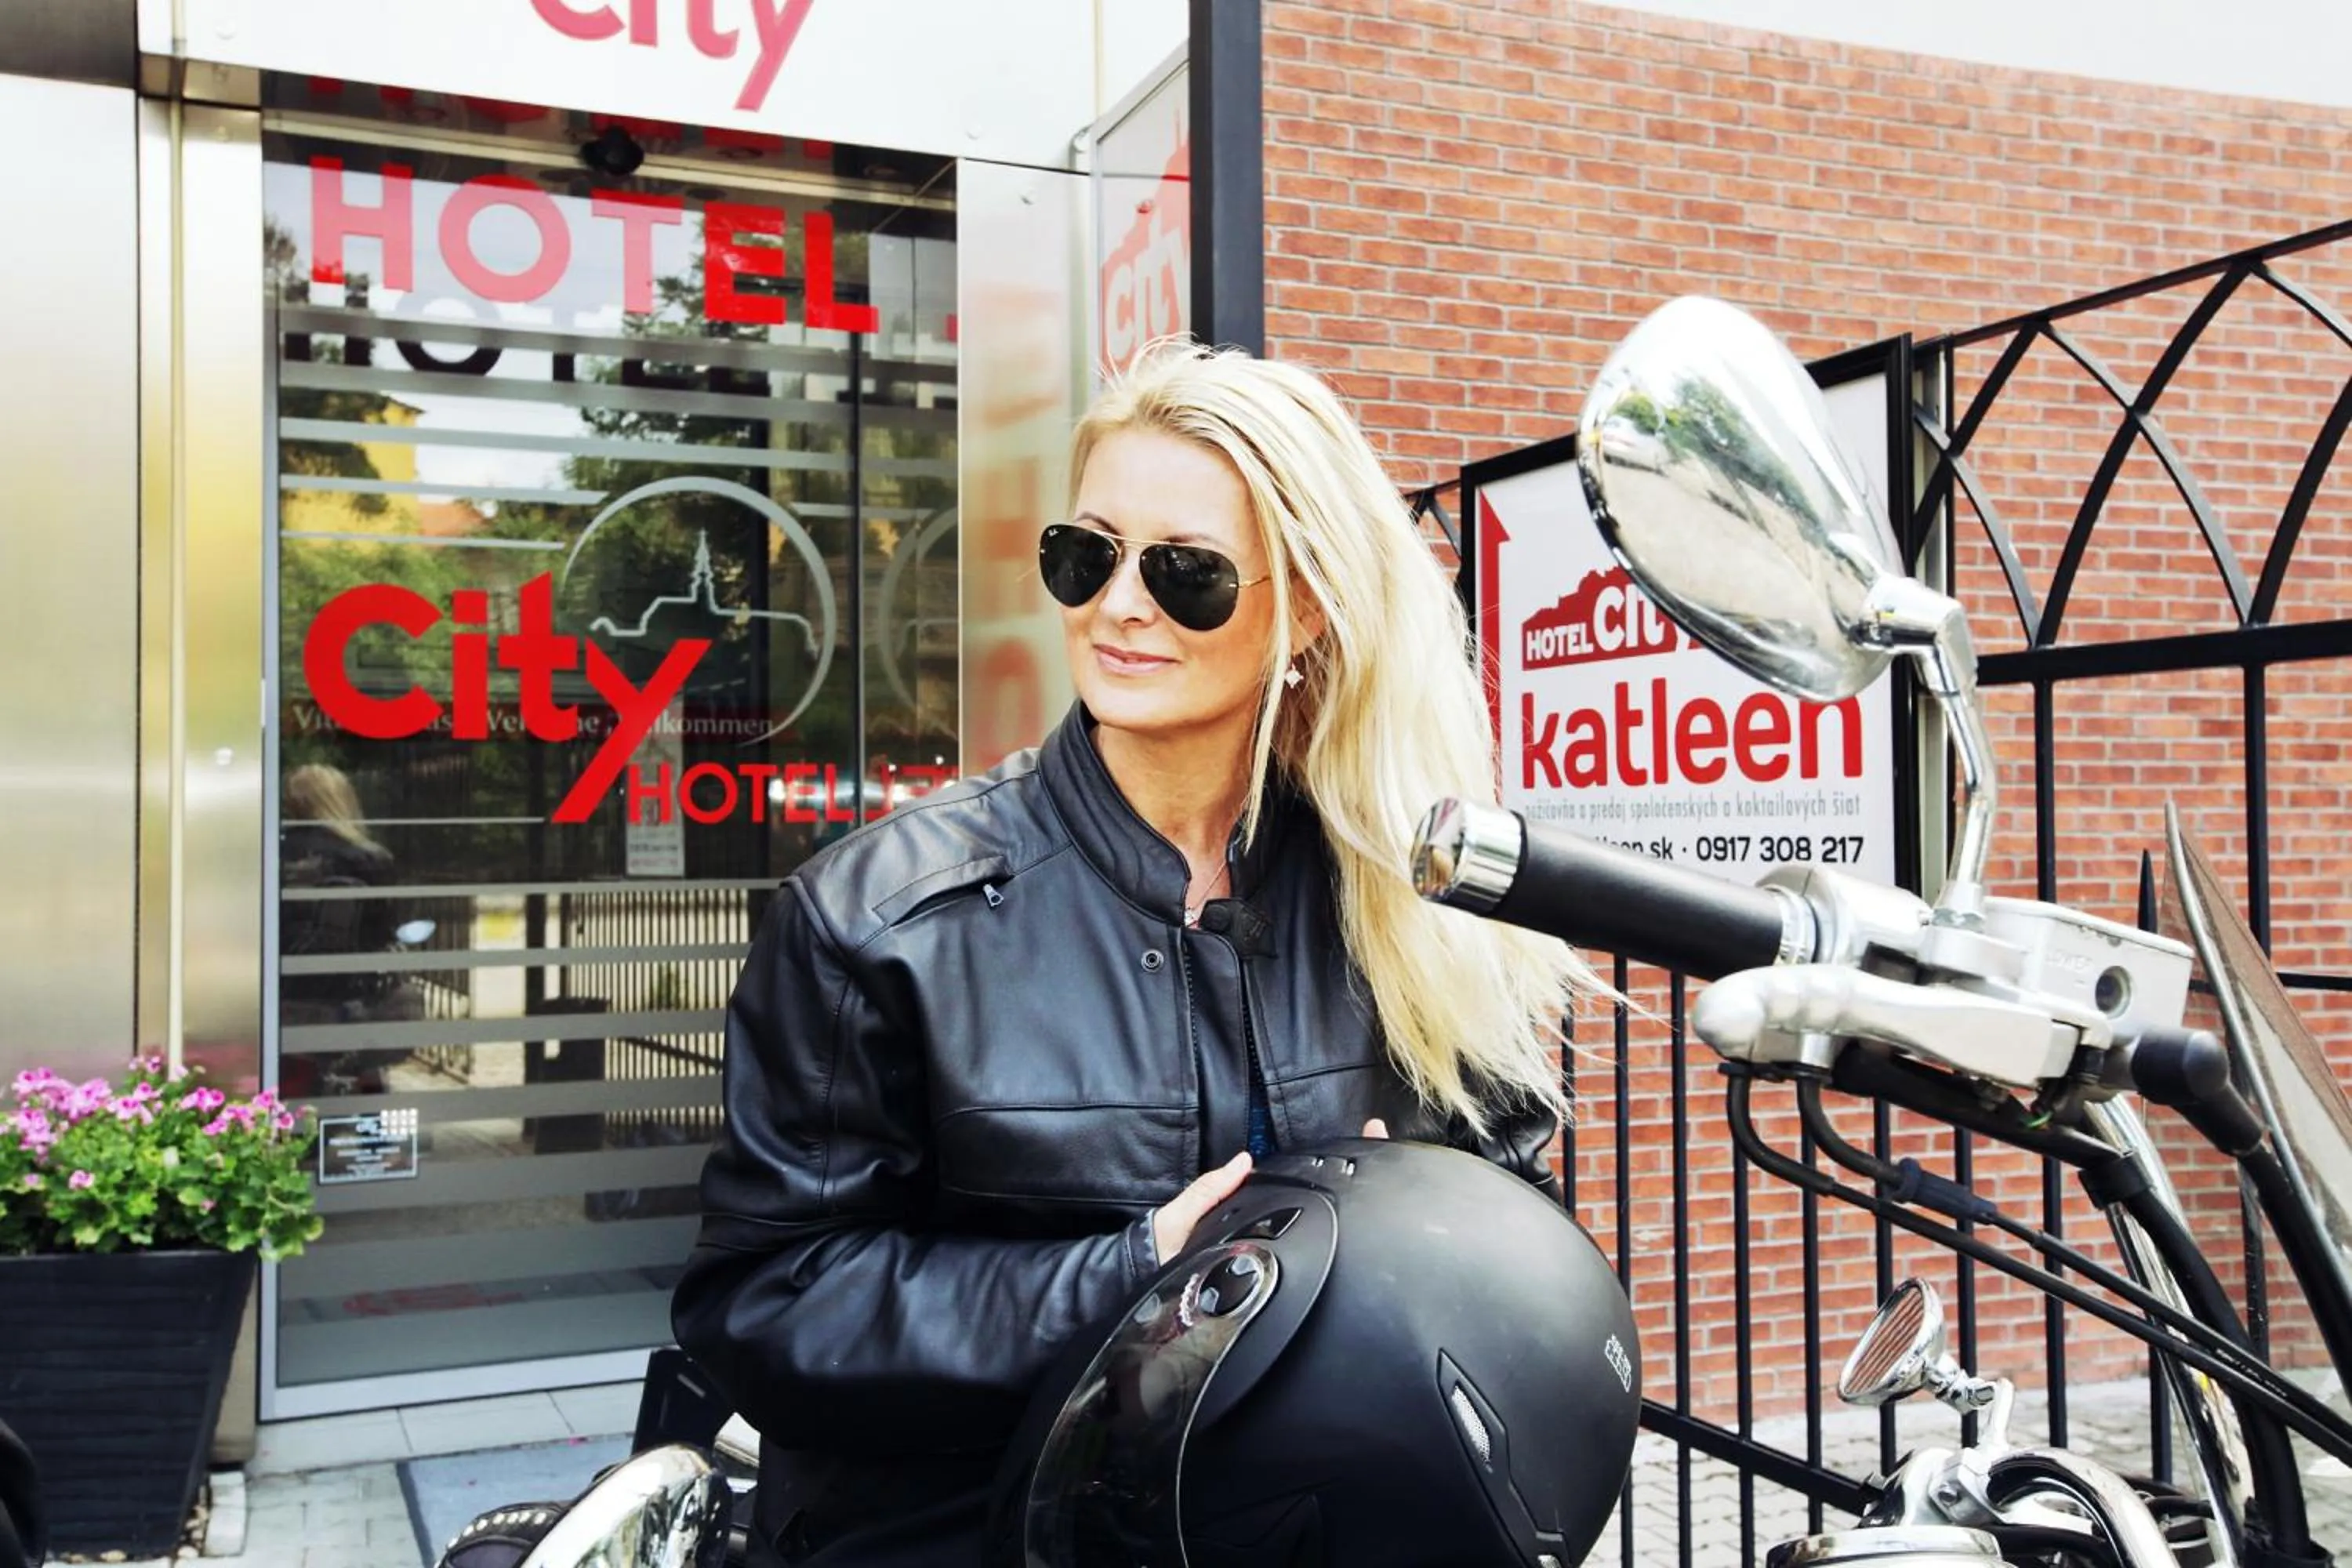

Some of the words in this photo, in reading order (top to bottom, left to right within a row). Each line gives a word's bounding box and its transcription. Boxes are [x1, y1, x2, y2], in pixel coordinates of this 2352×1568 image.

[310, 157, 879, 334] HOTEL
[1526, 622, 1595, 662] HOTEL
[303, 571, 713, 823] City
[1521, 677, 1863, 789] katleen
[629, 762, 855, 825] HOTEL
[1580, 804, 1588, 818] a
[1591, 795, 1626, 823] predaj
[1723, 800, 1731, 817] a
[1737, 789, 1826, 822] koktailových
[1696, 836, 1751, 862] 0917
[1760, 836, 1812, 862] 308
[1821, 836, 1864, 864] 217
